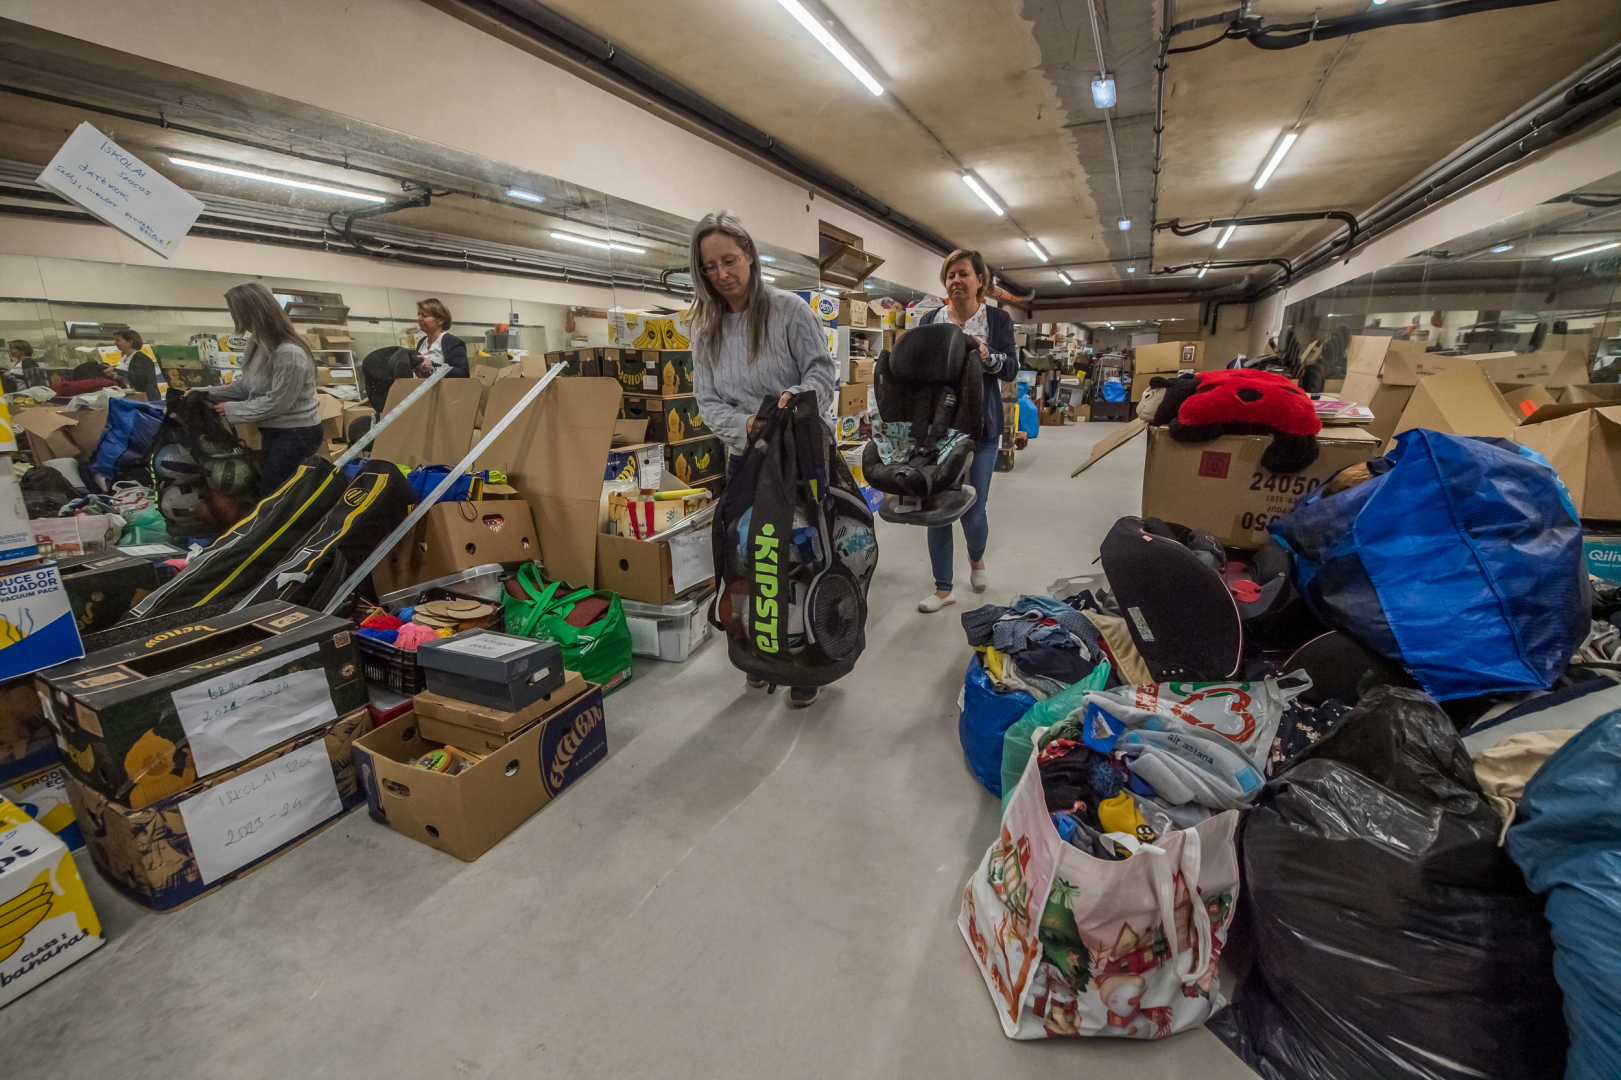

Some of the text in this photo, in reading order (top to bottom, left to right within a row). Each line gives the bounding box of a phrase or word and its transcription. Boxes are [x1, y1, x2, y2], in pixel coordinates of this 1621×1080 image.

[100, 141, 147, 178] ISKOLAI
[1250, 471, 1320, 495] 24050
[1266, 495, 1284, 503] 9293
[0, 578, 58, 597] CUADOR
[36, 569, 56, 580] OF
[37, 586, 60, 596] PACK
[754, 535, 780, 655] KIPSTA
[550, 706, 604, 790] EXCELBAN
[1167, 732, 1215, 766] air astana
[21, 771, 60, 790] PROD
[217, 771, 277, 808] ISKOLAI
[224, 817, 265, 847] 2023
[279, 797, 302, 818] 24
[0, 927, 90, 988] bananas
[21, 938, 58, 964] CLASS
